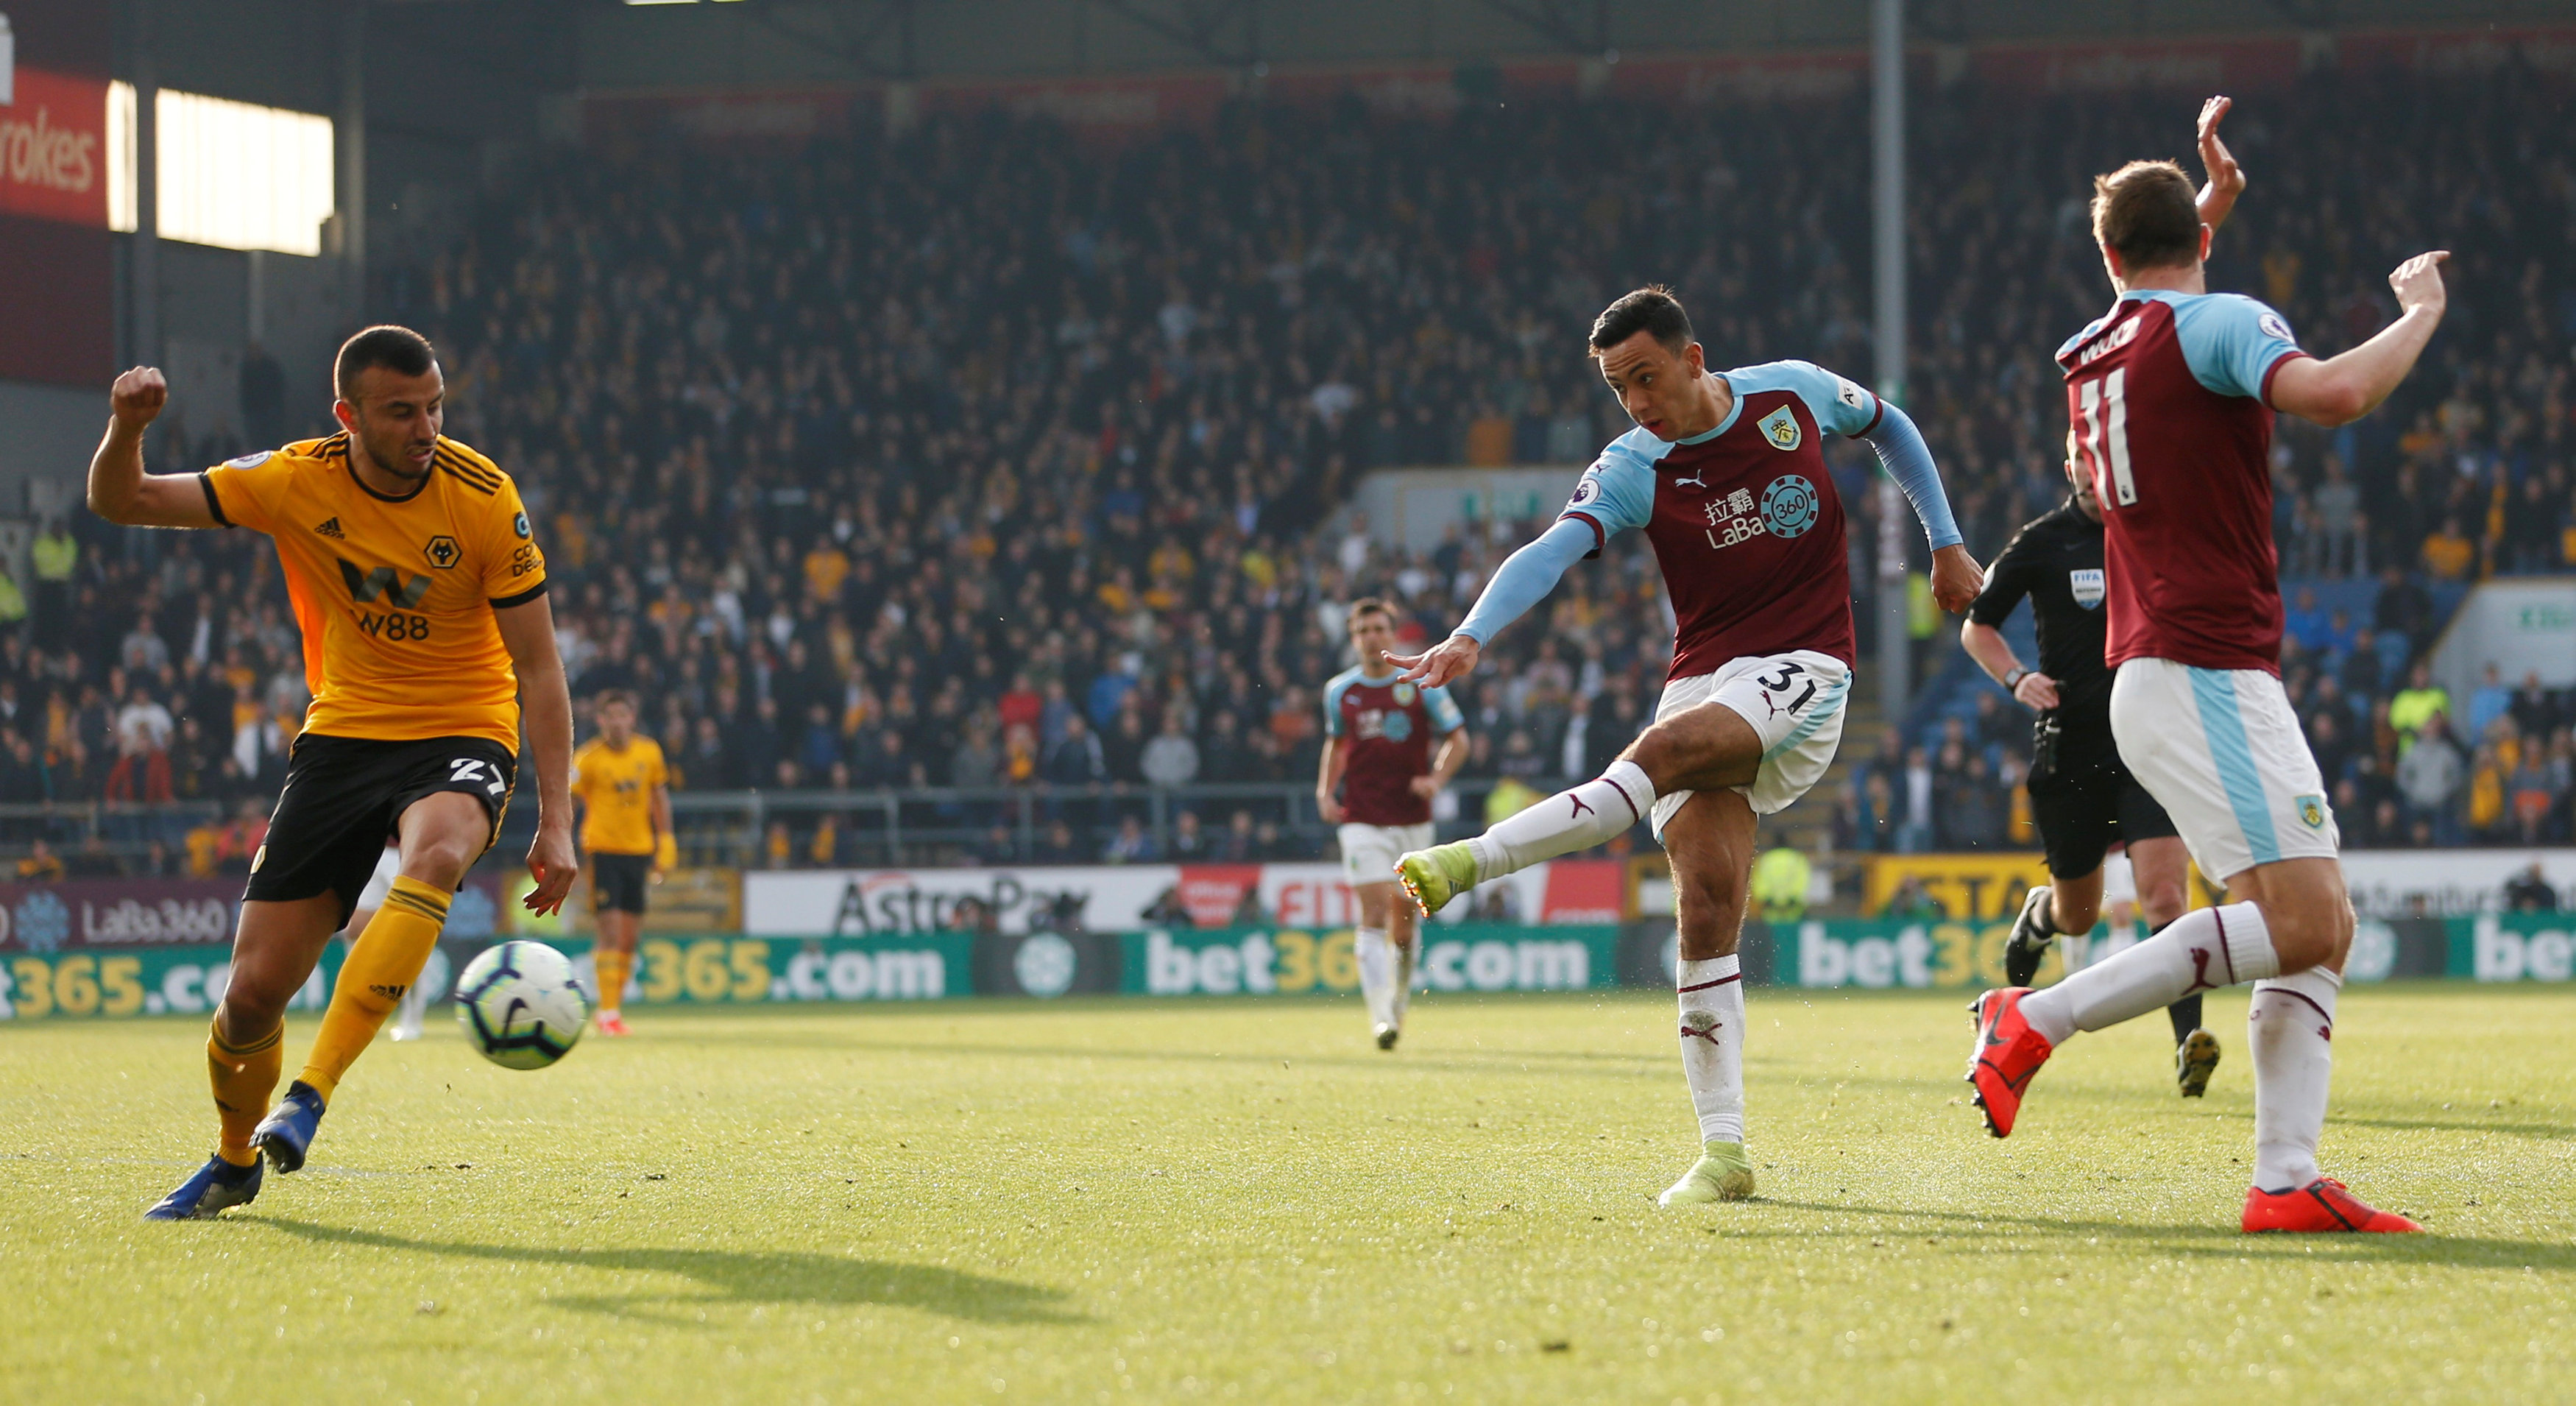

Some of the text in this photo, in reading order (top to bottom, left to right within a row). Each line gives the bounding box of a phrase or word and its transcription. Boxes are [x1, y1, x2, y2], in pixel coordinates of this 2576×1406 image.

[2080, 367, 2139, 511] 11
[1705, 487, 1755, 526] 拉霸
[1775, 494, 1805, 520] 360
[1706, 516, 1766, 550] LaBa
[2074, 572, 2100, 582] FIFA
[350, 609, 429, 641] W88
[1757, 662, 1816, 716] 31
[81, 897, 227, 944] LaBa360
[1147, 929, 1590, 994] bet36.com
